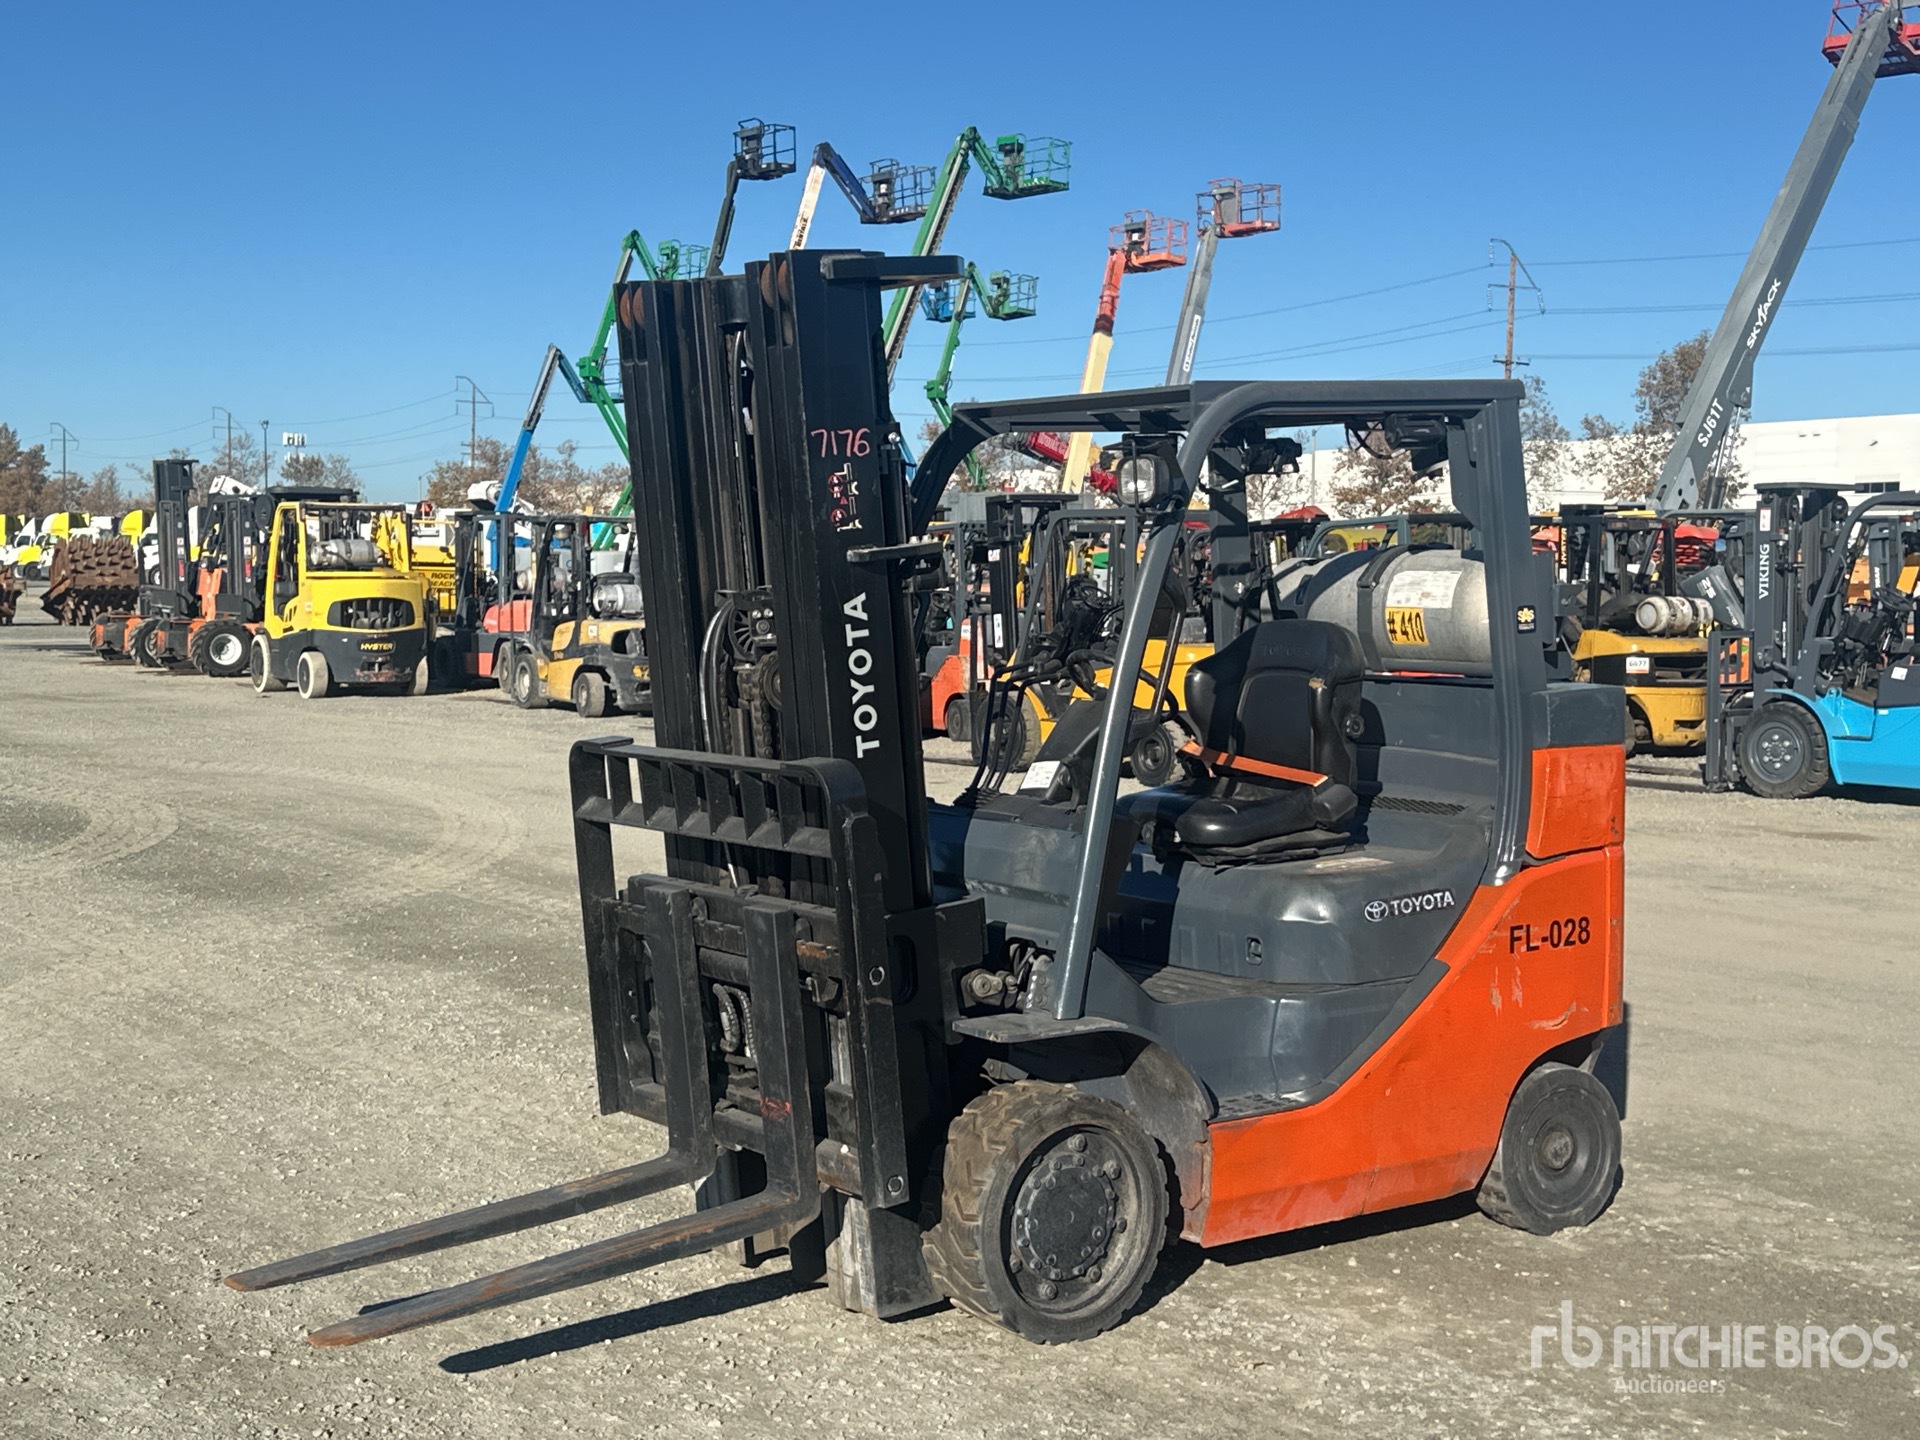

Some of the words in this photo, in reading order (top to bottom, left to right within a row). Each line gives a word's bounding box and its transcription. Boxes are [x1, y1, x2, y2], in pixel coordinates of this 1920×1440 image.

[1746, 277, 1782, 350] SKYJACK
[810, 427, 871, 458] 7176
[1697, 397, 1724, 448] SJ61T
[1758, 543, 1771, 600] VIKING
[360, 642, 394, 651] HYSTER
[843, 591, 883, 759] TOYOTA
[1390, 891, 1455, 916] TOYOTA
[1508, 916, 1591, 954] FL-028
